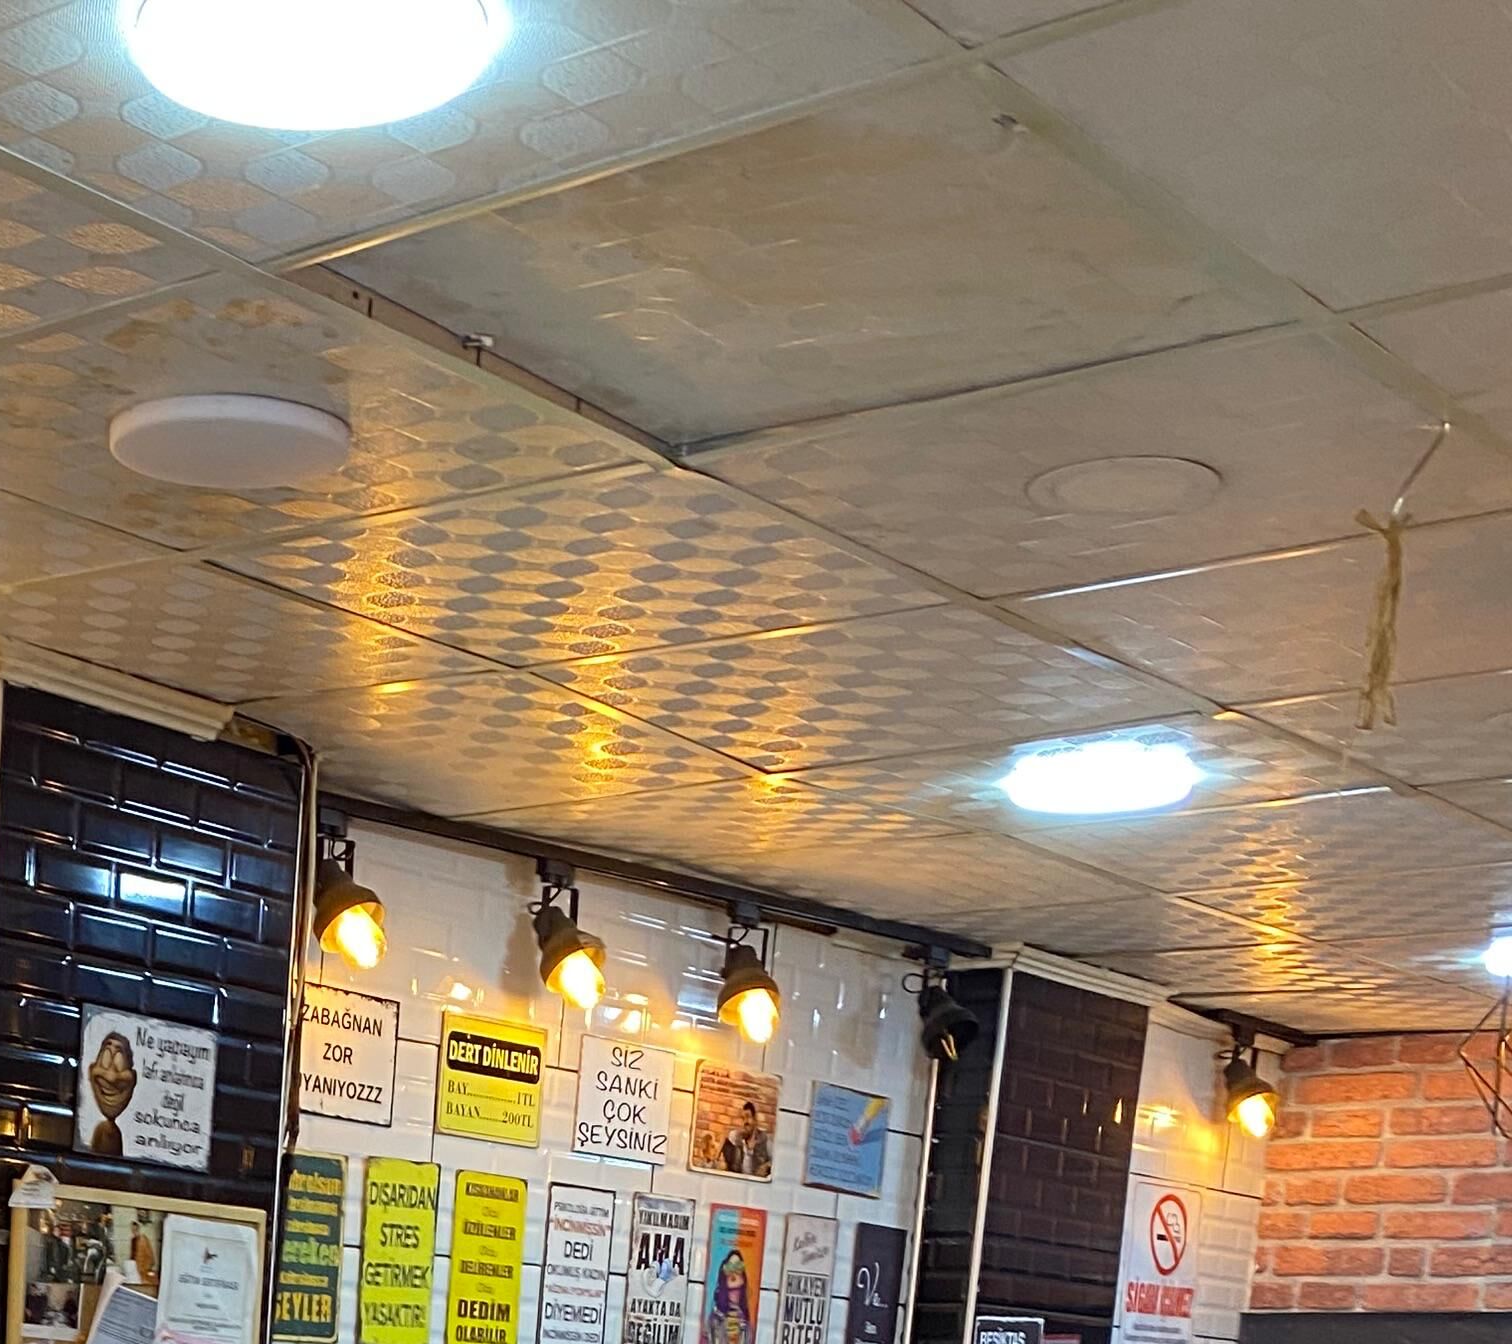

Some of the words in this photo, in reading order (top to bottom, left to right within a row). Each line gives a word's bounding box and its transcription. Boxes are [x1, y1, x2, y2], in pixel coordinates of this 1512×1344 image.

[302, 1004, 383, 1037] ZABAĞNAN
[136, 1026, 155, 1049] Ne
[323, 1042, 353, 1065] ZOR
[448, 1036, 481, 1065] DERT
[482, 1041, 539, 1076] DİNLENİR
[611, 1045, 644, 1071] SİZ
[596, 1070, 659, 1101] SANKİ
[603, 1099, 646, 1125] ÇOK
[577, 1122, 667, 1154] ŞEYSİNİZ
[369, 1181, 436, 1213] DIŞARIDAN
[380, 1222, 420, 1249] STRES
[564, 1239, 594, 1262] DEDİ
[457, 1295, 510, 1323] DEDİM
[545, 1299, 602, 1325] DİYEMEDİ
[631, 1298, 666, 1316] AYAKTA
[669, 1301, 680, 1317] DA
[783, 1296, 825, 1324] MUTLU
